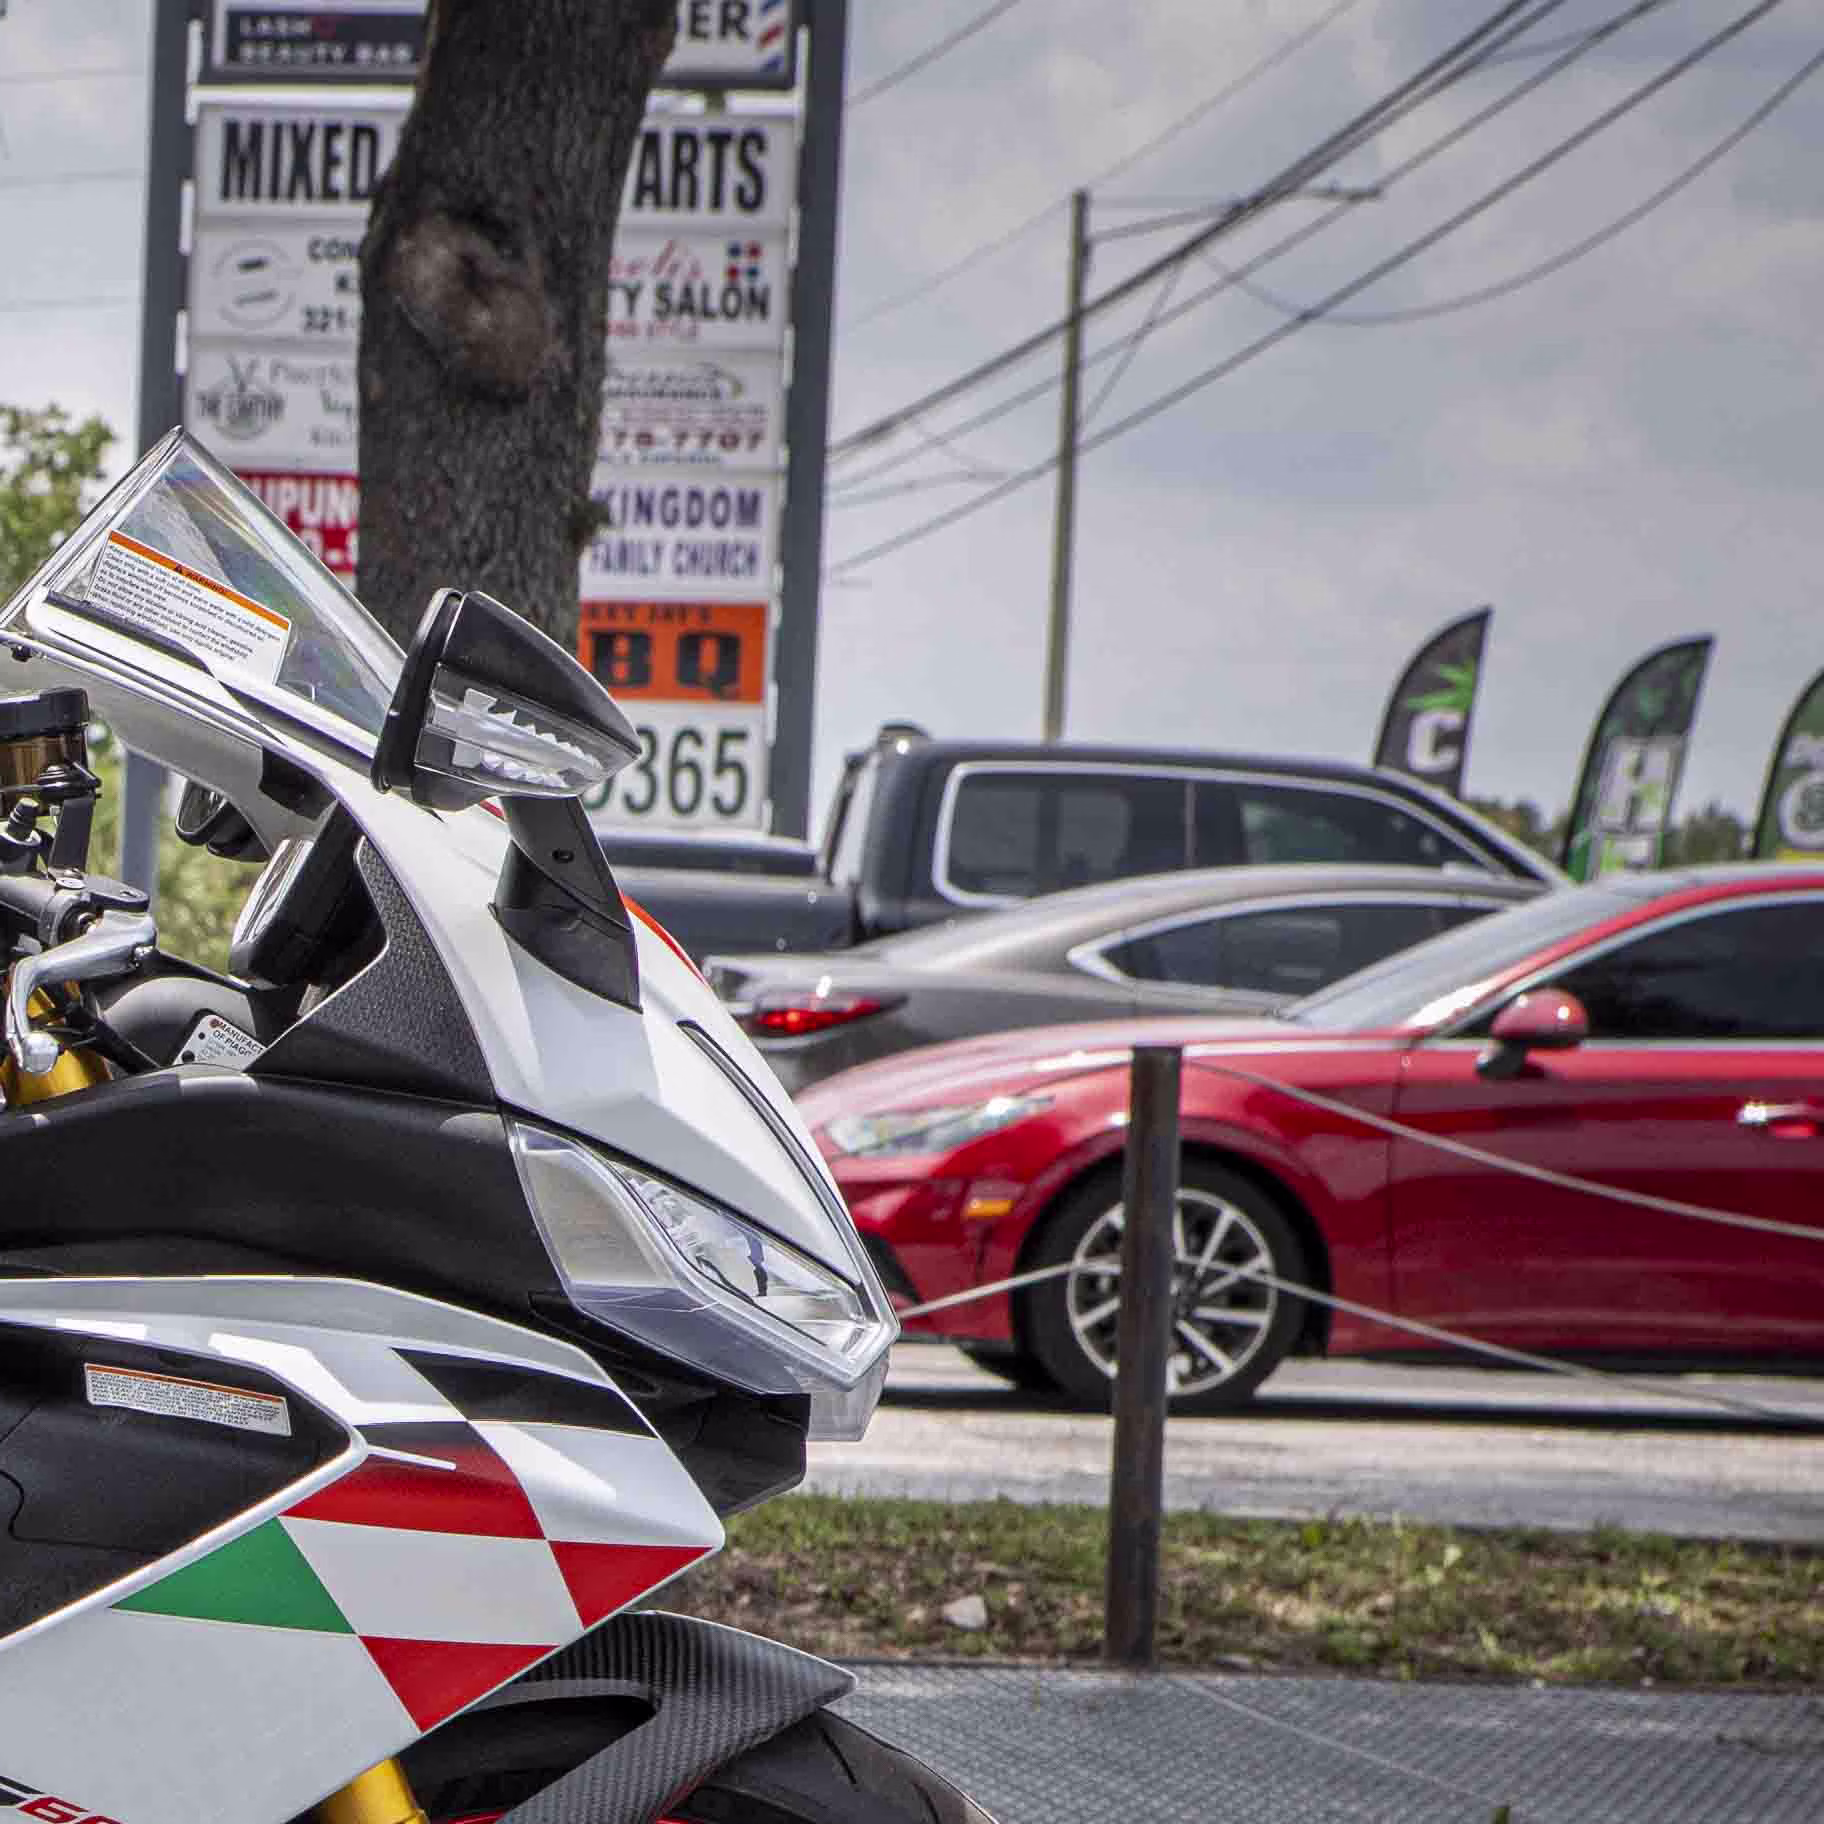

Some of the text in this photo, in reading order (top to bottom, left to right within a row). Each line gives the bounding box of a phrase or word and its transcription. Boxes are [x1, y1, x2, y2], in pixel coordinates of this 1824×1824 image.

[221, 120, 767, 213] MIXED ARTS
[655, 282, 770, 320] SALON
[592, 539, 757, 577] FAMILY CHURCH
